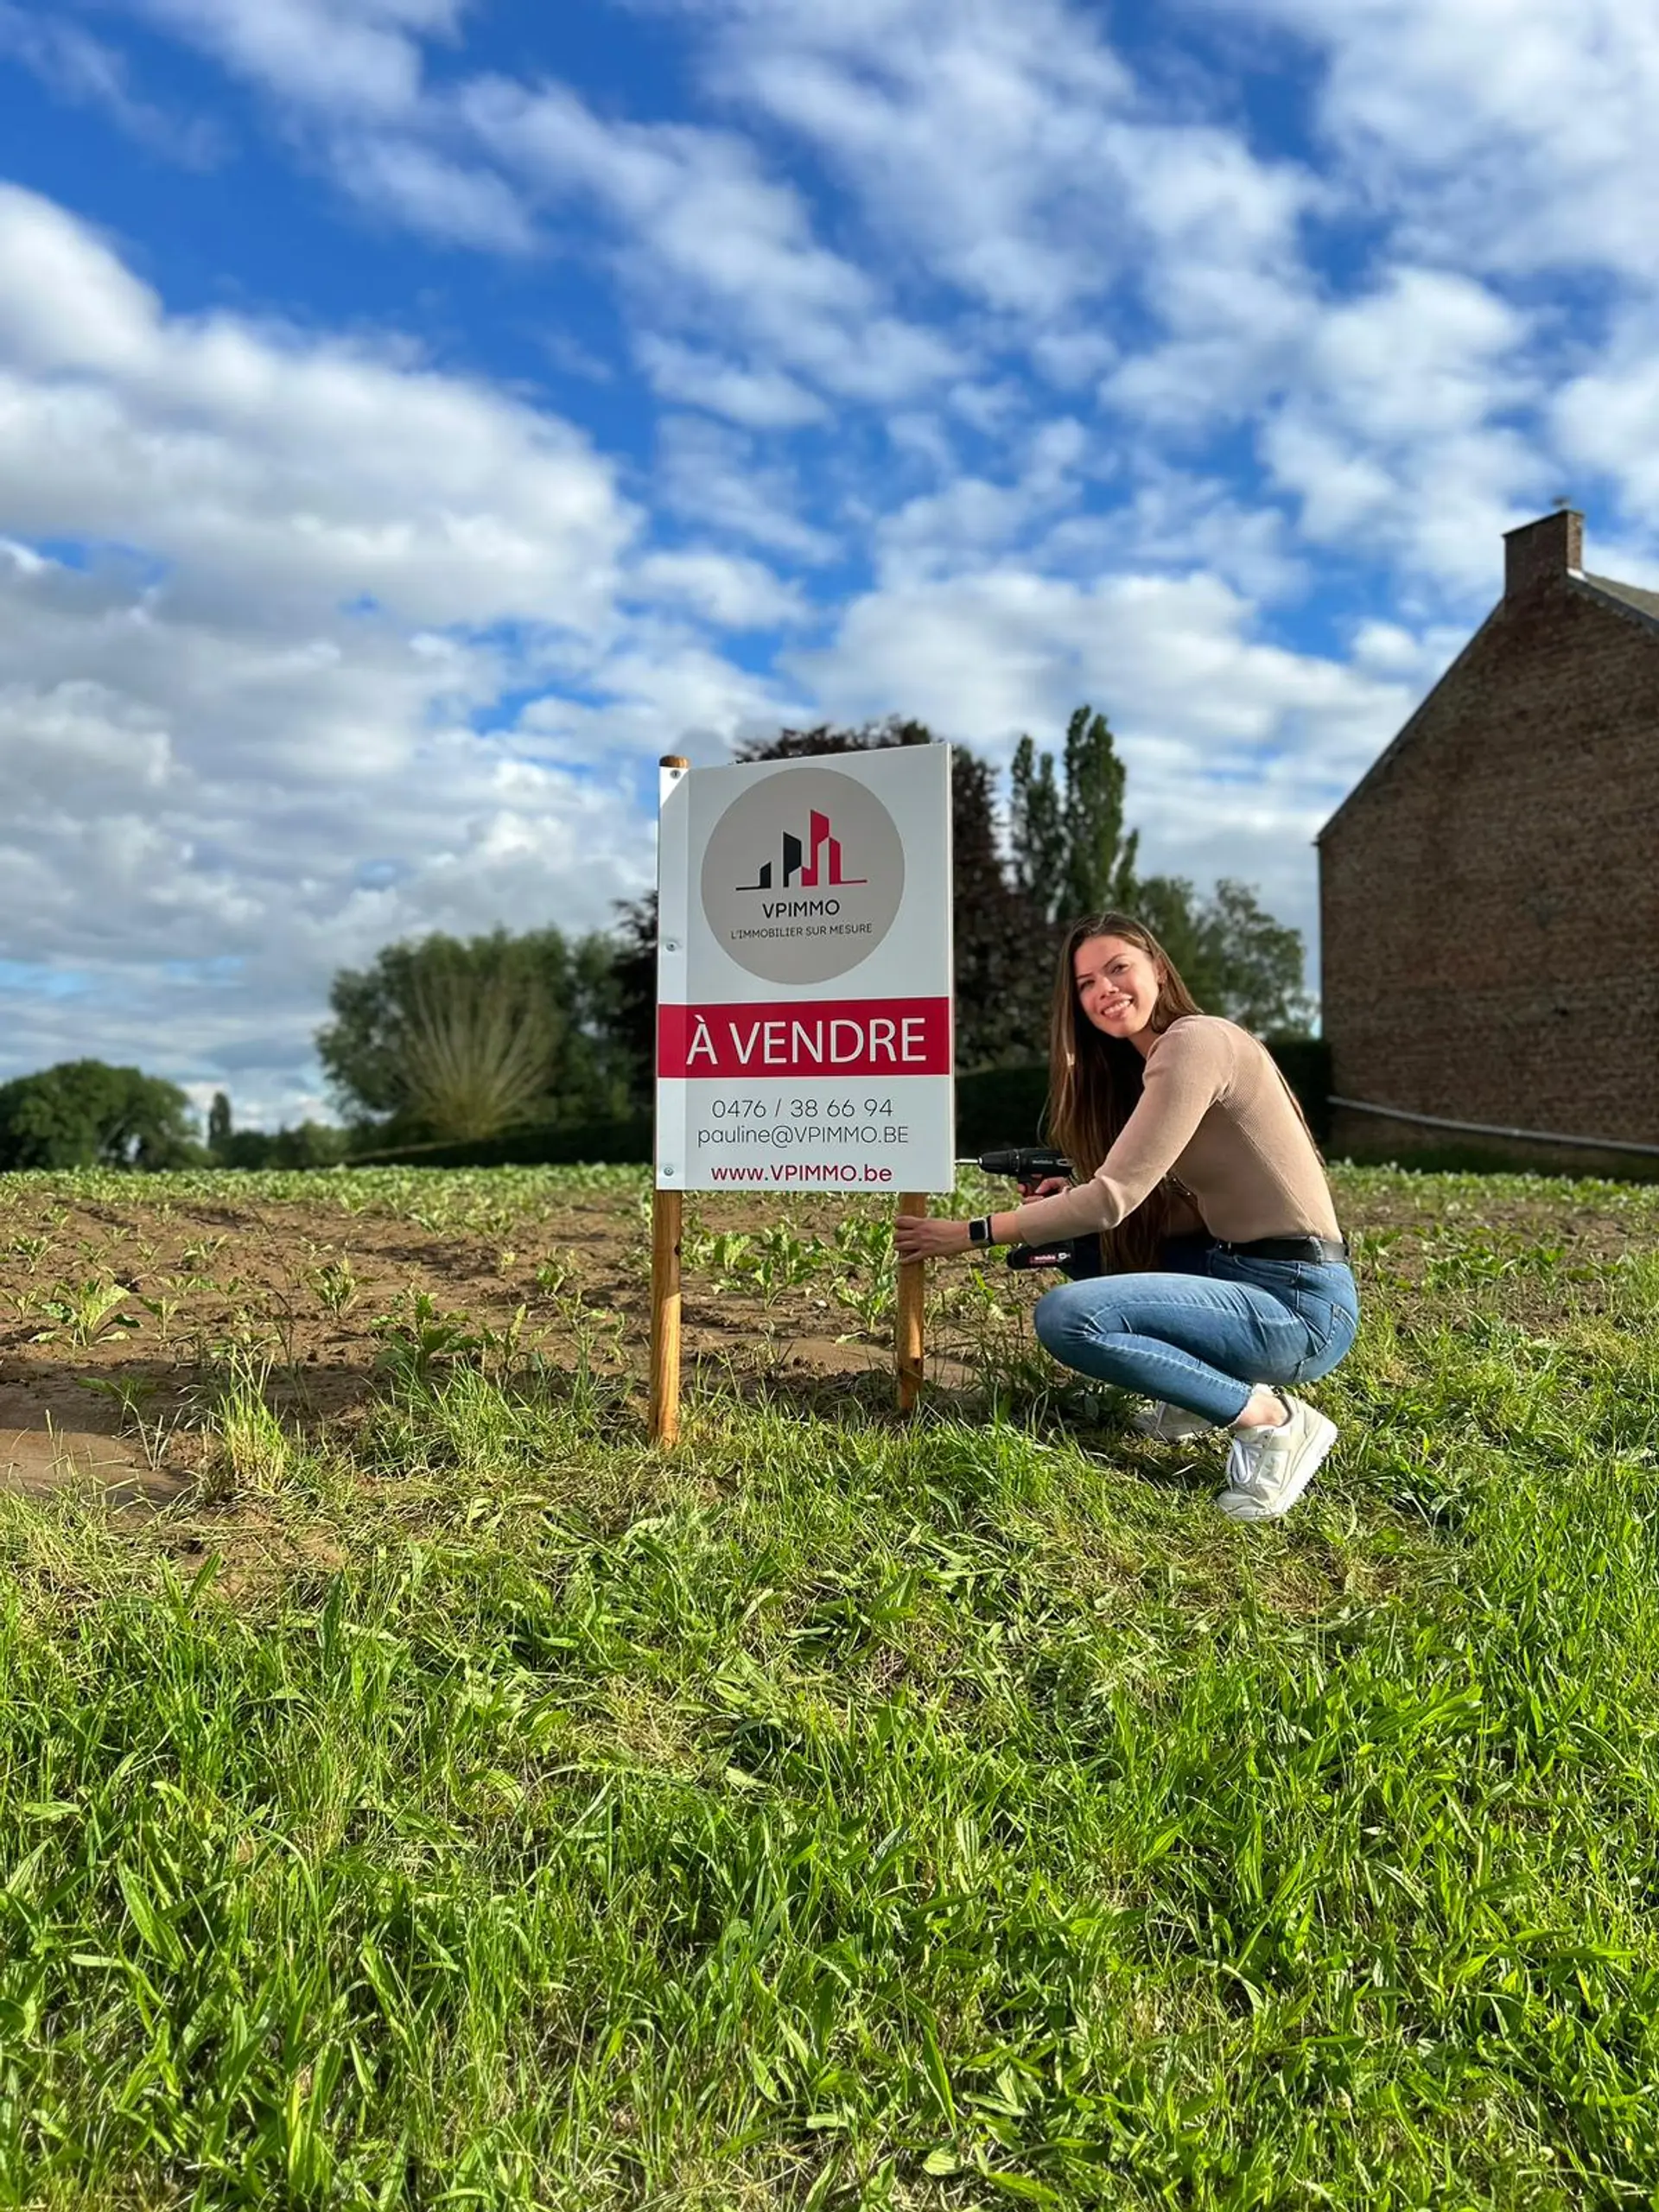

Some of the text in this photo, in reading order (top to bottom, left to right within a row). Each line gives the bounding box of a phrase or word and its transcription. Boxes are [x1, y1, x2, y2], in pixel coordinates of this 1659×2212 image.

[762, 899, 840, 918] VPIMMO
[730, 923, 873, 940] L'IMMOBILIER SUR MESURE
[686, 1014, 926, 1065] À VENDRE
[711, 1098, 893, 1118] 0476 / 38 66 94
[697, 1125, 909, 1148] pauline@VPIMMO.BE
[711, 1164, 893, 1182] www.VPIMMO.be
